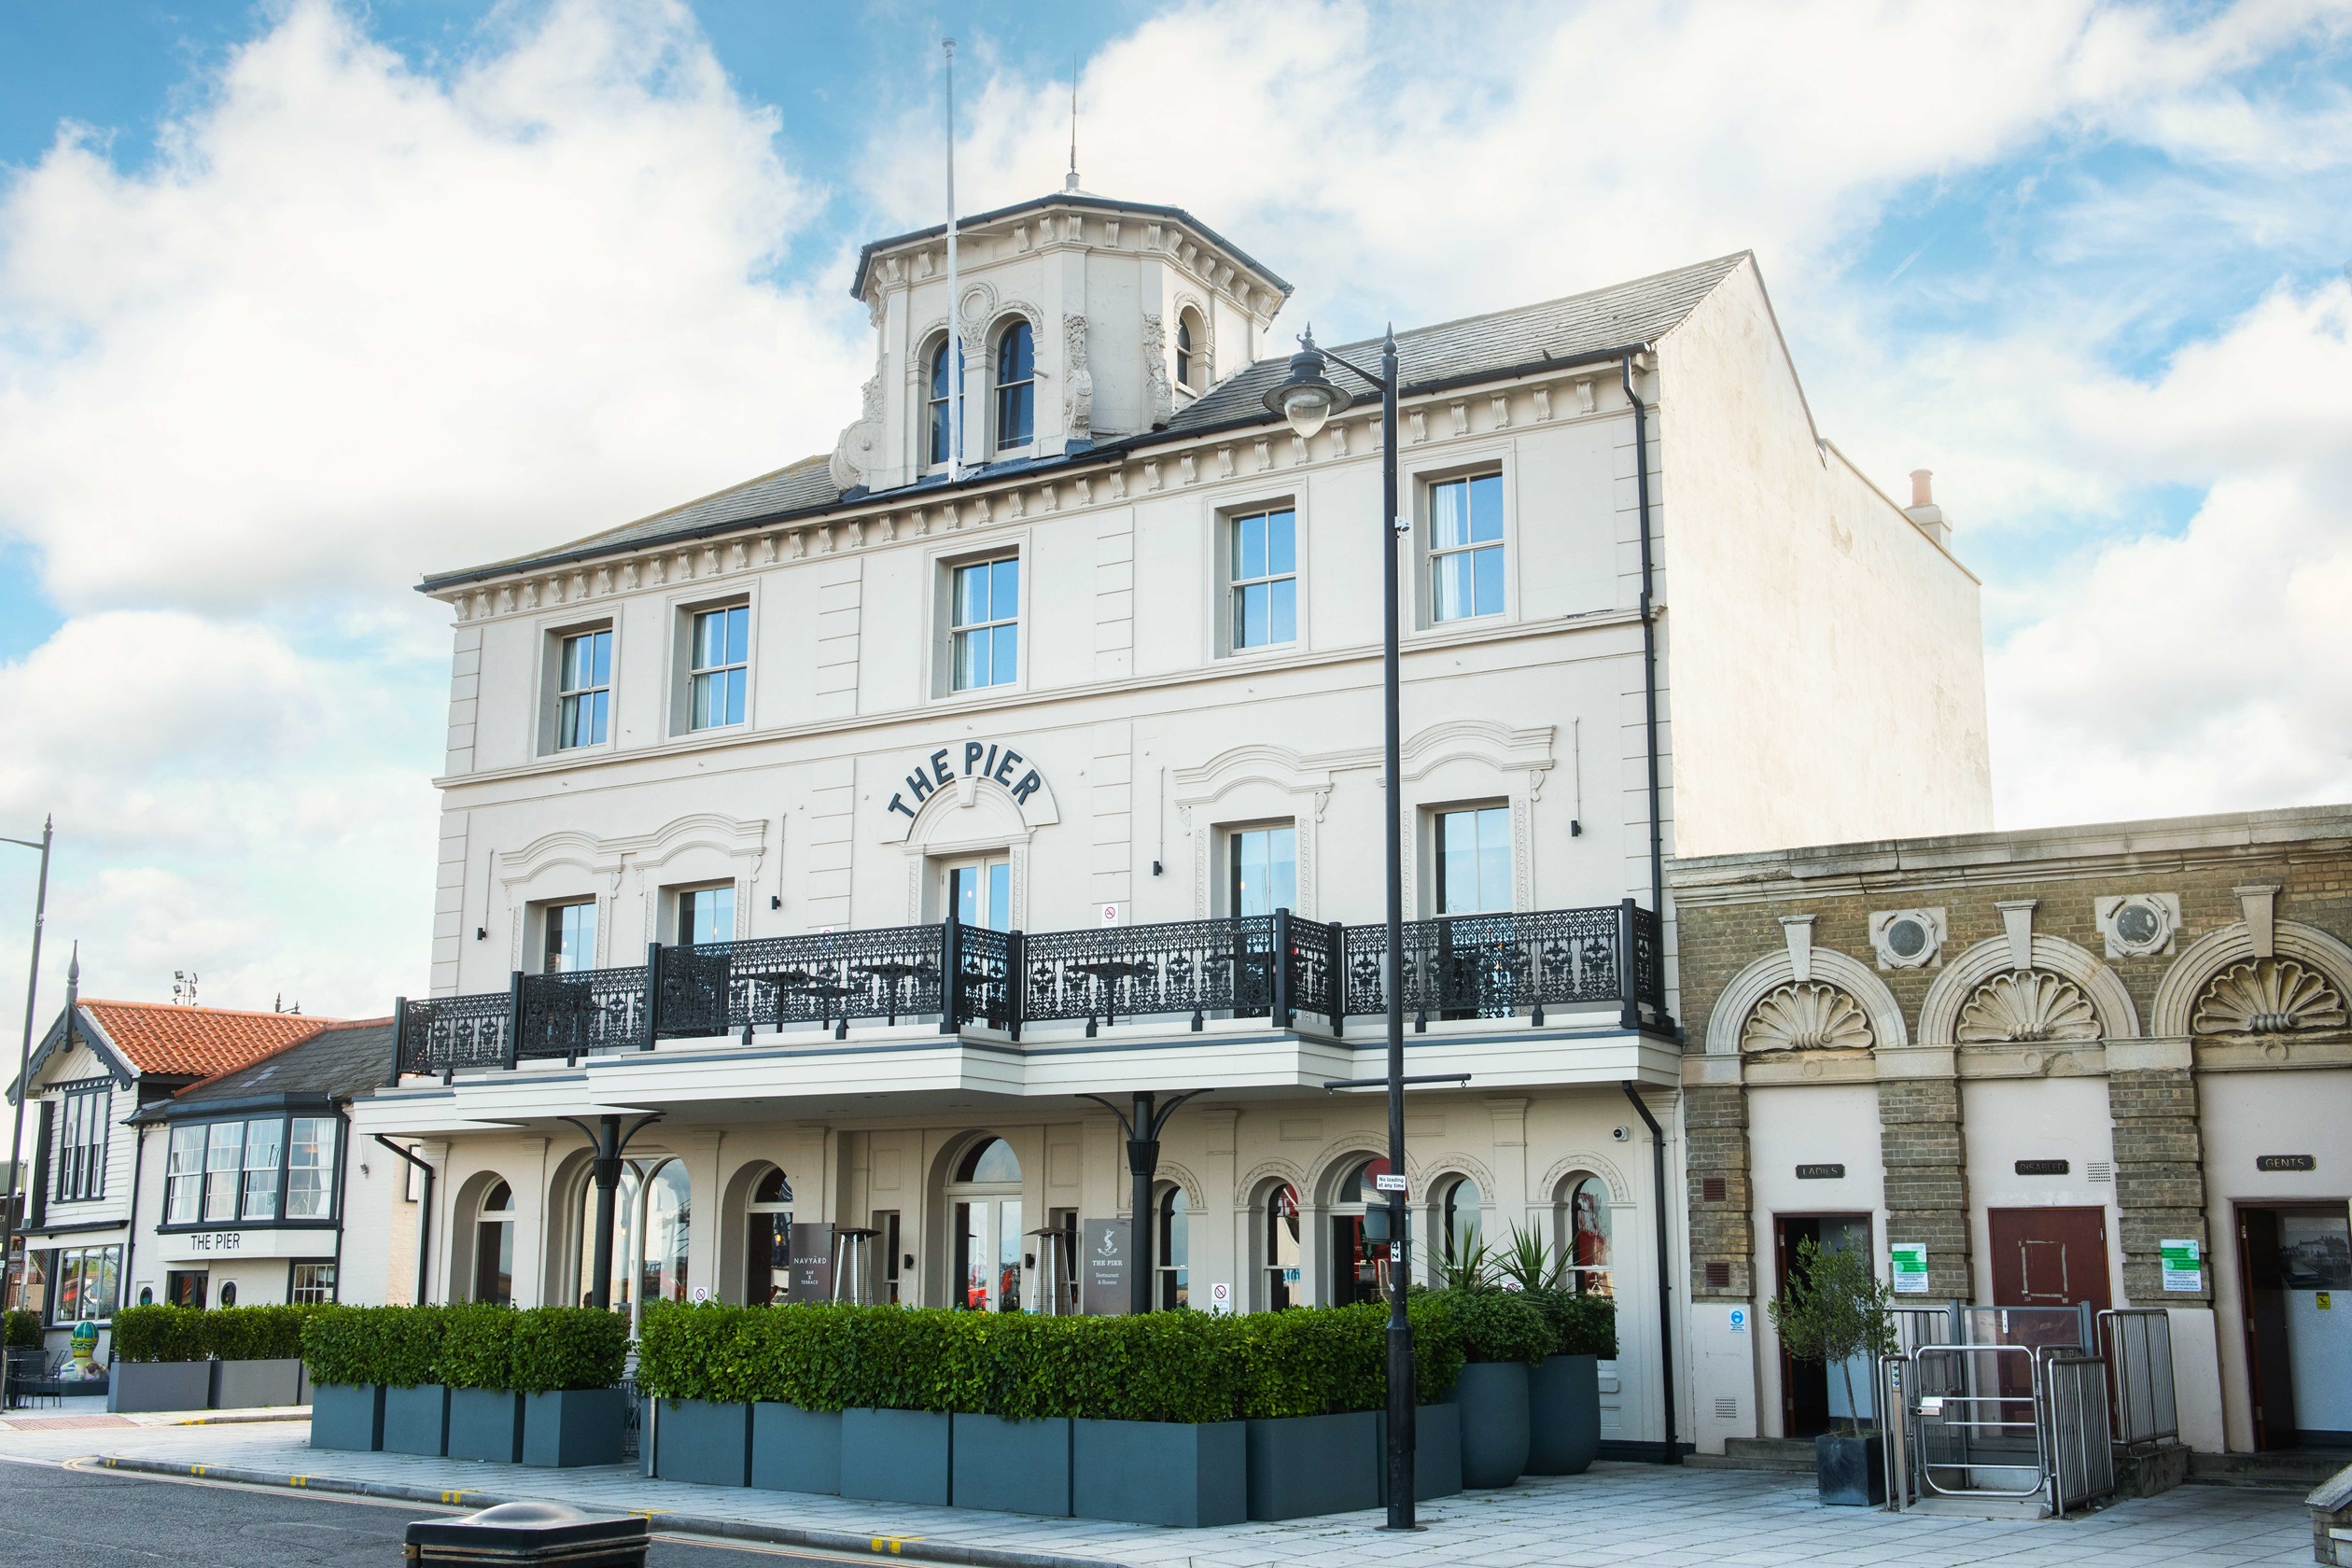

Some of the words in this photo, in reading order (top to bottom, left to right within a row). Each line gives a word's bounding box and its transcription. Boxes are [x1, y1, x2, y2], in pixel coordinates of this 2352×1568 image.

[888, 749, 955, 819] THE
[965, 742, 1041, 805] PIER
[2020, 1163, 2065, 1172] DISABLED
[2265, 1158, 2304, 1168] GENTS
[1802, 1167, 1838, 1176] LADIES
[191, 1234, 211, 1251] THE
[216, 1233, 241, 1250] PIER
[1392, 1240, 1399, 1251] 4
